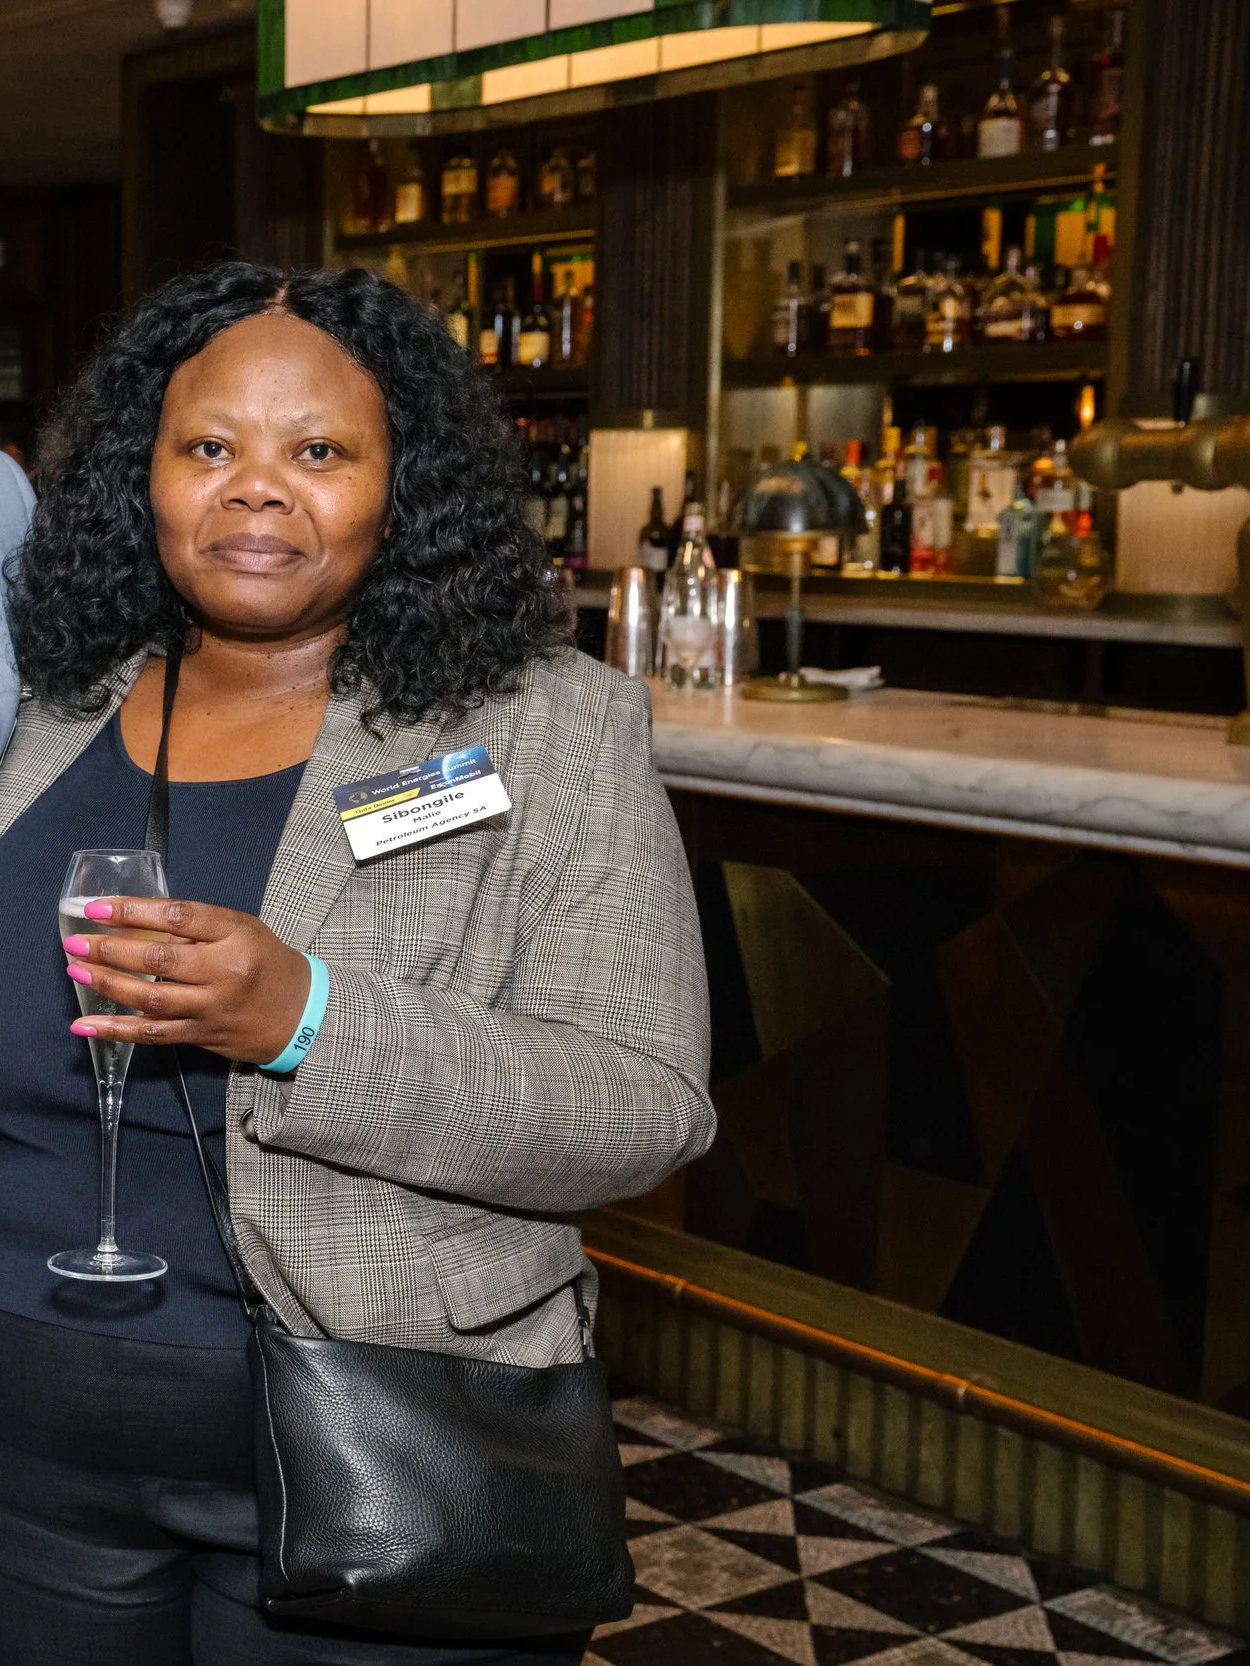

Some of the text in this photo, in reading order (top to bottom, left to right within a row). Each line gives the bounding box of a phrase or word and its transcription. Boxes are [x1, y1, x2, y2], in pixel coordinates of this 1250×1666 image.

[371, 783, 399, 795] World
[401, 770, 441, 786] Energies
[444, 758, 477, 772] ummit
[430, 769, 482, 790] ExxonMobil
[355, 799, 395, 814] Gala Dinner
[382, 792, 465, 824] Sibongile
[376, 805, 487, 846] Petroleum Agency SA
[294, 1027, 315, 1051] 190
